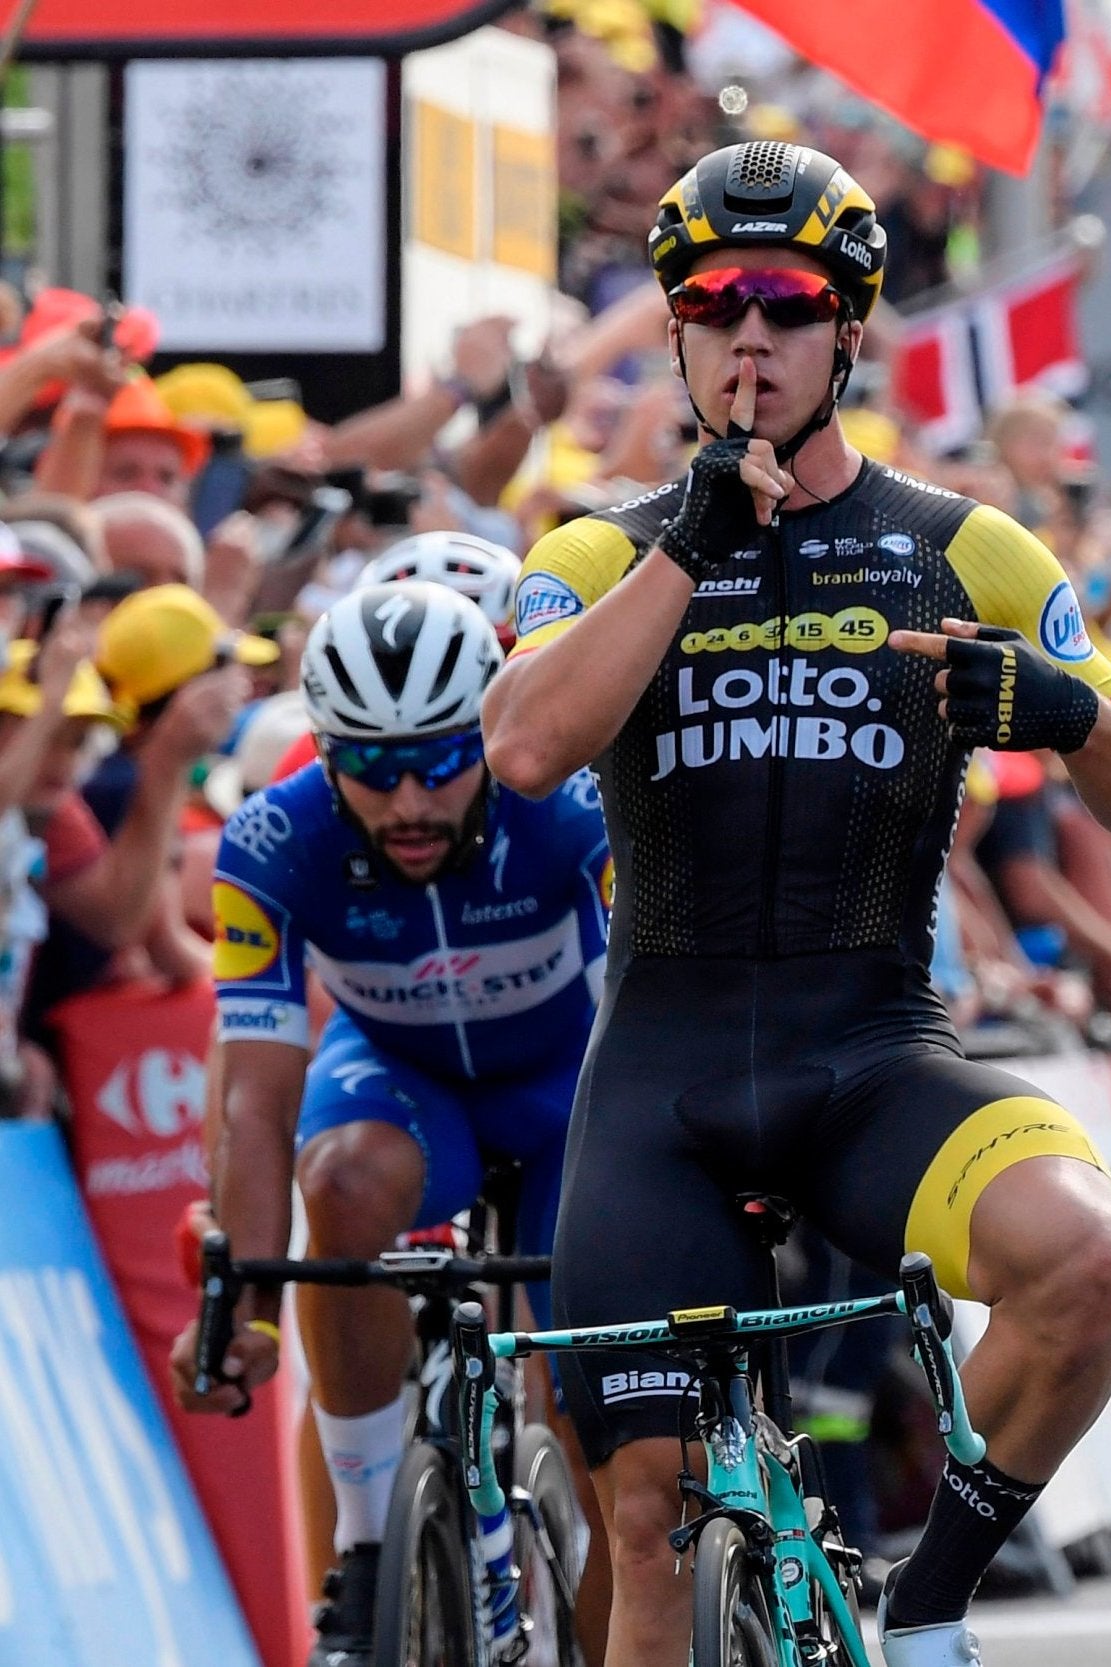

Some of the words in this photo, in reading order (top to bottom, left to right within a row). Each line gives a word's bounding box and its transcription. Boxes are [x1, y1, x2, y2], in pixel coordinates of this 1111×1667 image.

[730, 221, 788, 234] LAZER
[884, 468, 962, 499] JUMBO
[812, 567, 923, 588] brandloyalty
[707, 633, 725, 643] 24
[738, 629, 751, 642] 6
[796, 622, 824, 638] 15
[838, 619, 875, 637] 45
[678, 657, 882, 717] Lotto.
[996, 644, 1018, 744] JUMBO
[650, 715, 904, 782] JUMBO
[677, 1310, 723, 1322] Pioneer
[740, 1302, 855, 1329] Bianchi
